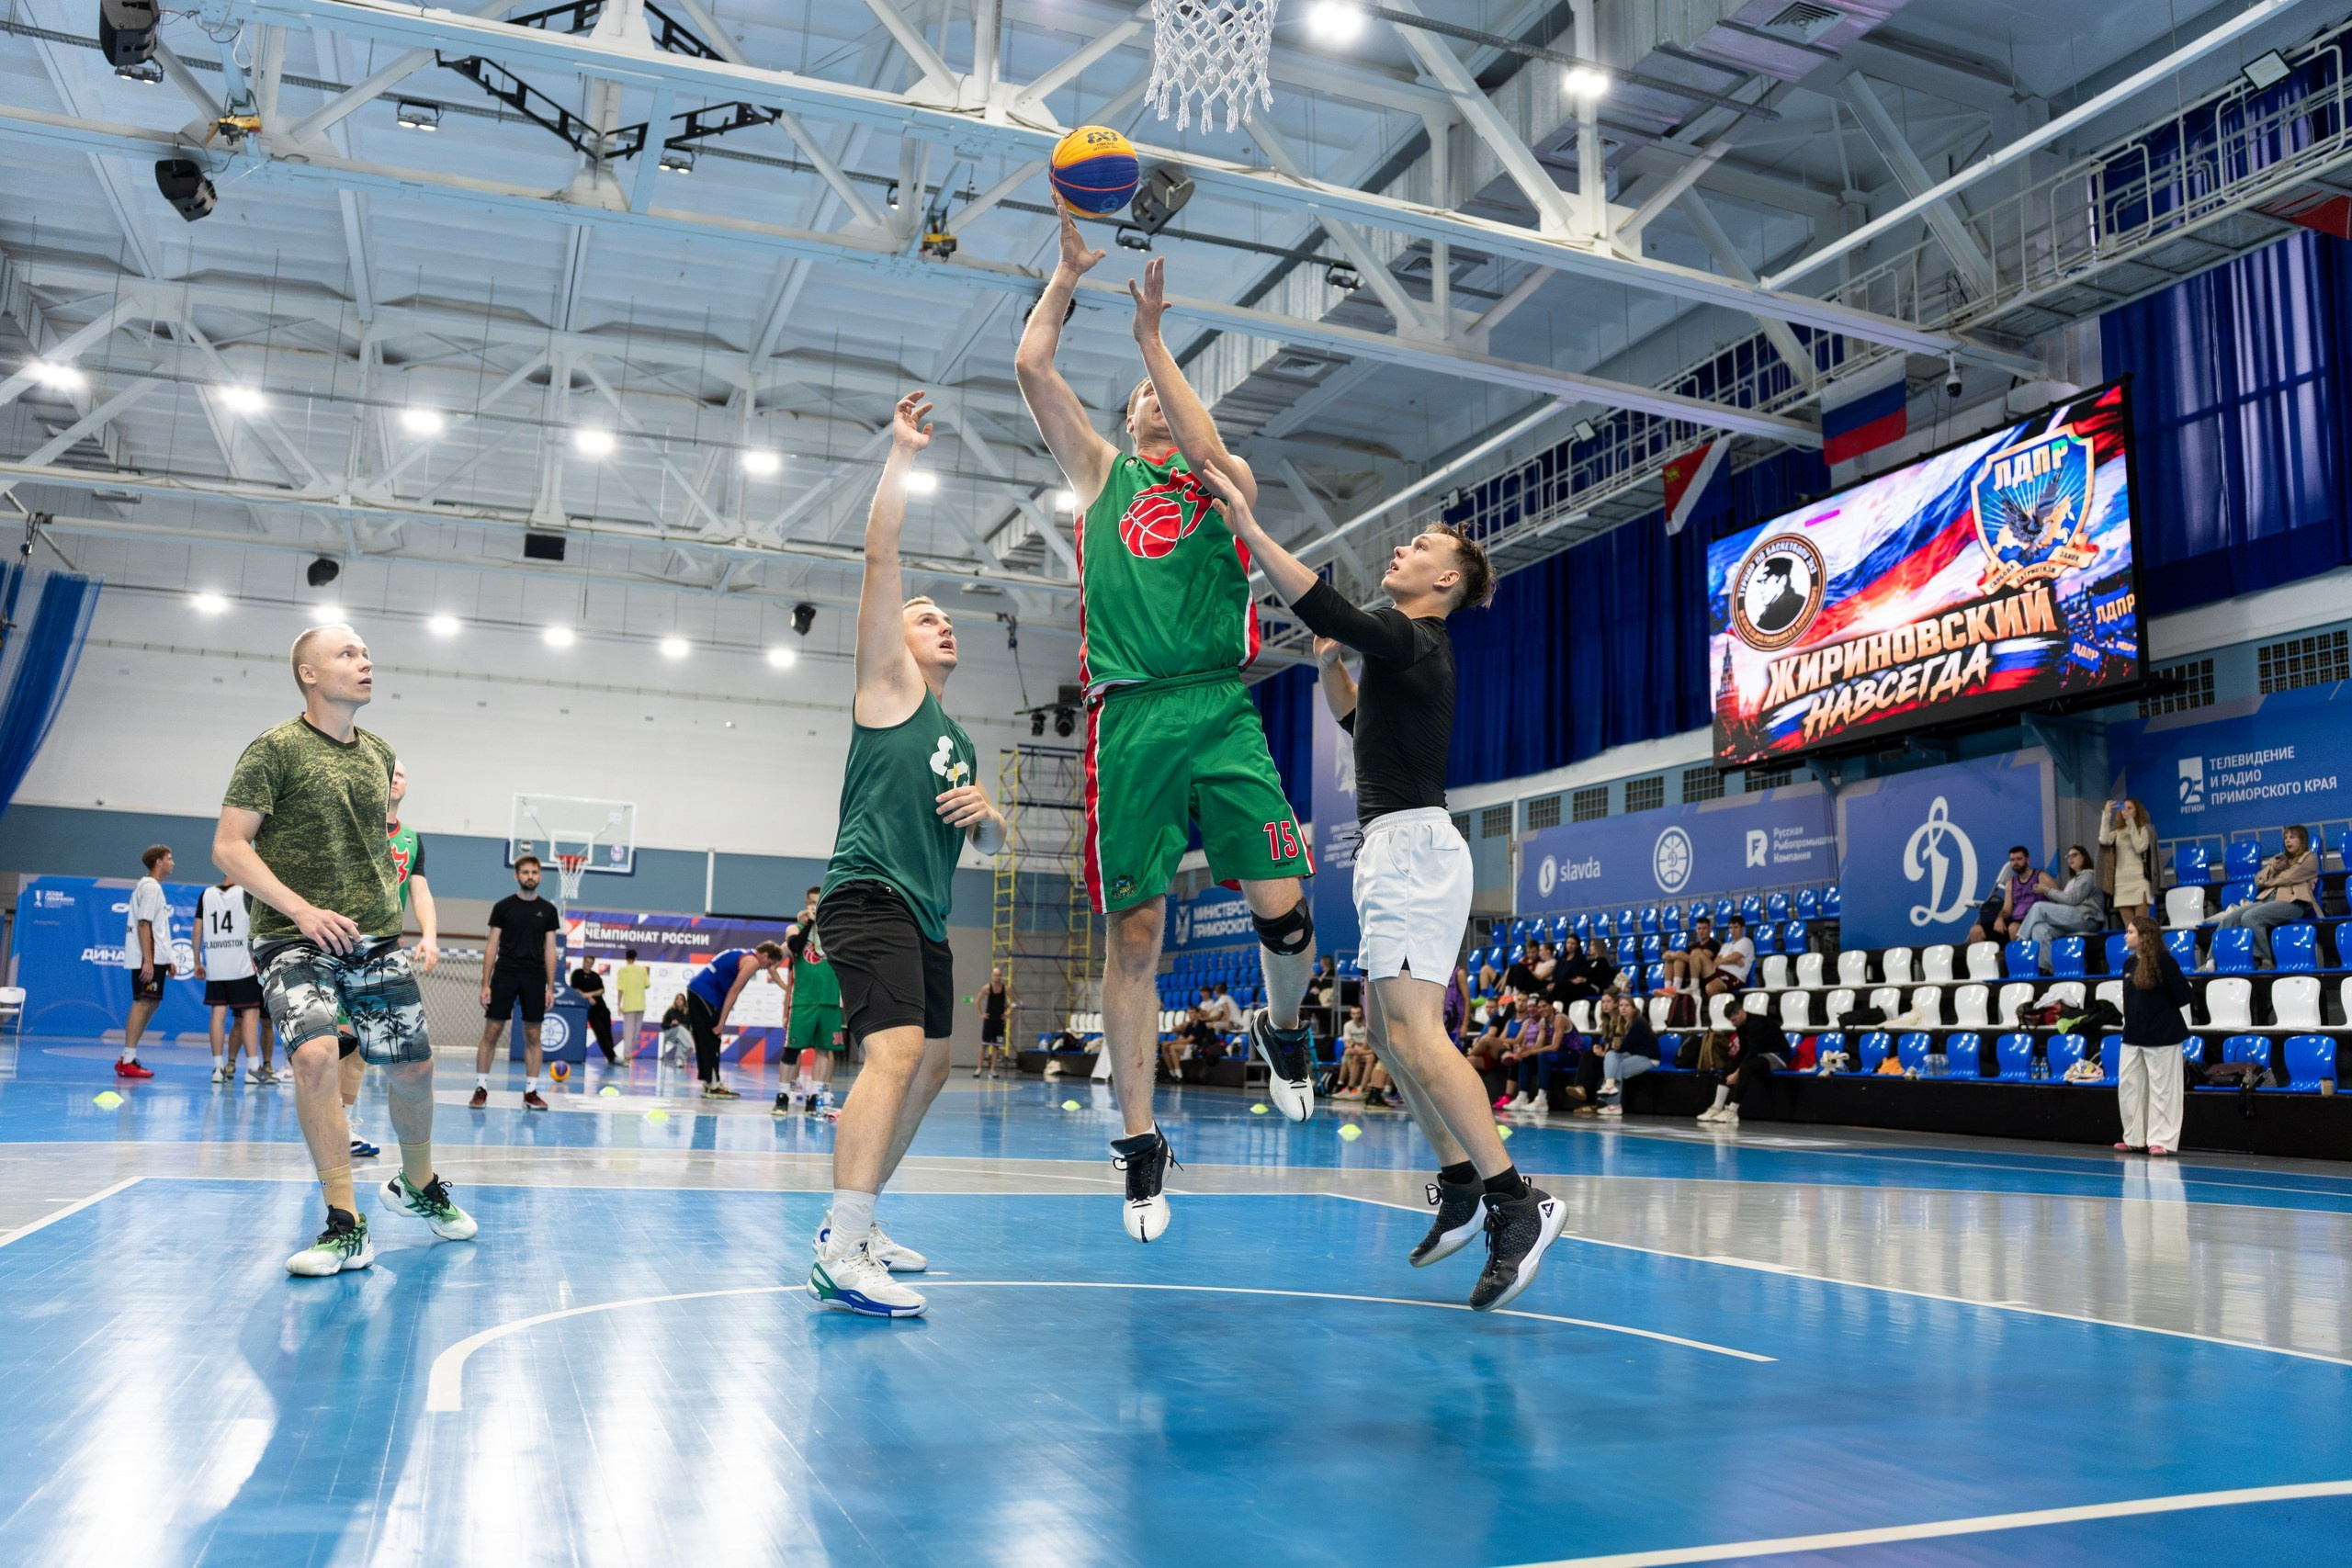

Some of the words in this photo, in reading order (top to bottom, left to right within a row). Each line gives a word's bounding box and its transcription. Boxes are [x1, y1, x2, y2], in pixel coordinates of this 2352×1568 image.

[1993, 438, 2068, 491] ЛДПР
[2096, 592, 2135, 625] ЛДПР
[1761, 581, 2059, 711] ЖИРИНОВСКИЙ
[1803, 642, 1993, 742] НАВСЕГДА
[2209, 746, 2295, 771] ТЕЛЕВИДЕНИЕ
[2210, 775, 2218, 788] И
[2222, 769, 2262, 788] РАДИО
[2211, 782, 2301, 806] ПРИМОРСКОГО
[2304, 776, 2337, 793] КРАЯ
[2180, 804, 2205, 814] РЕГИОН
[1263, 820, 1299, 861] 15
[1773, 826, 1804, 840] Русская
[1560, 855, 1601, 882] slavda
[1773, 852, 1812, 863] Компания
[210, 909, 233, 934] 14
[1193, 899, 1250, 921] МИНИСТЕРСТ
[204, 939, 243, 950] VLADIVOSTOK
[585, 927, 660, 943] ЧЕМПИОНАТ
[662, 932, 709, 946] РОССИИ
[81, 948, 125, 962] ДИНА
